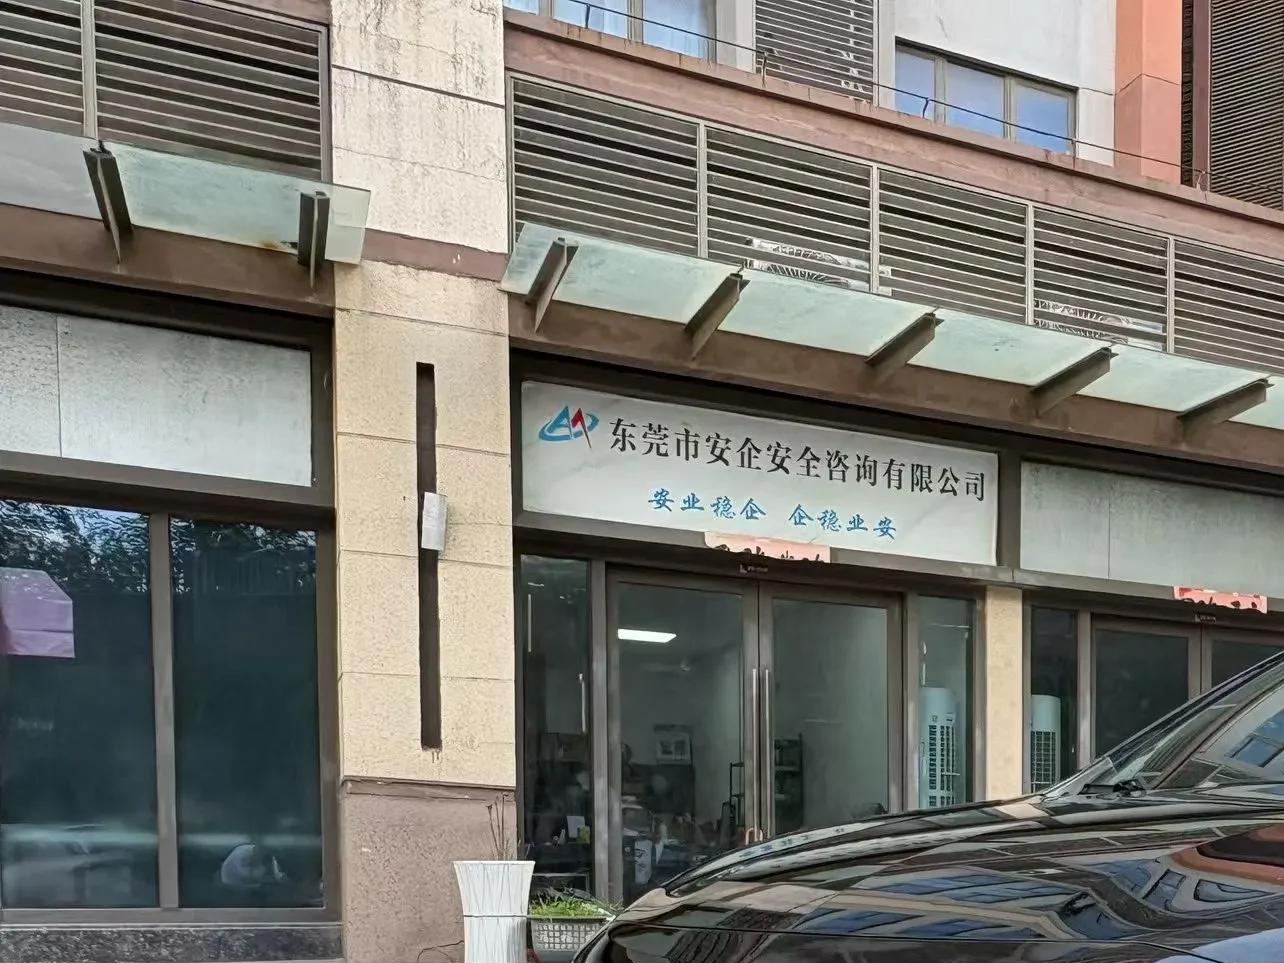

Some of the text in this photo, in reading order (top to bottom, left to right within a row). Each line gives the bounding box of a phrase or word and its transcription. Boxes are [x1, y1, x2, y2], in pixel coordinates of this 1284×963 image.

[609, 417, 986, 502] 东莞市安企安全咨询有限公司
[648, 488, 897, 540] 安业稳企 企稳业安
